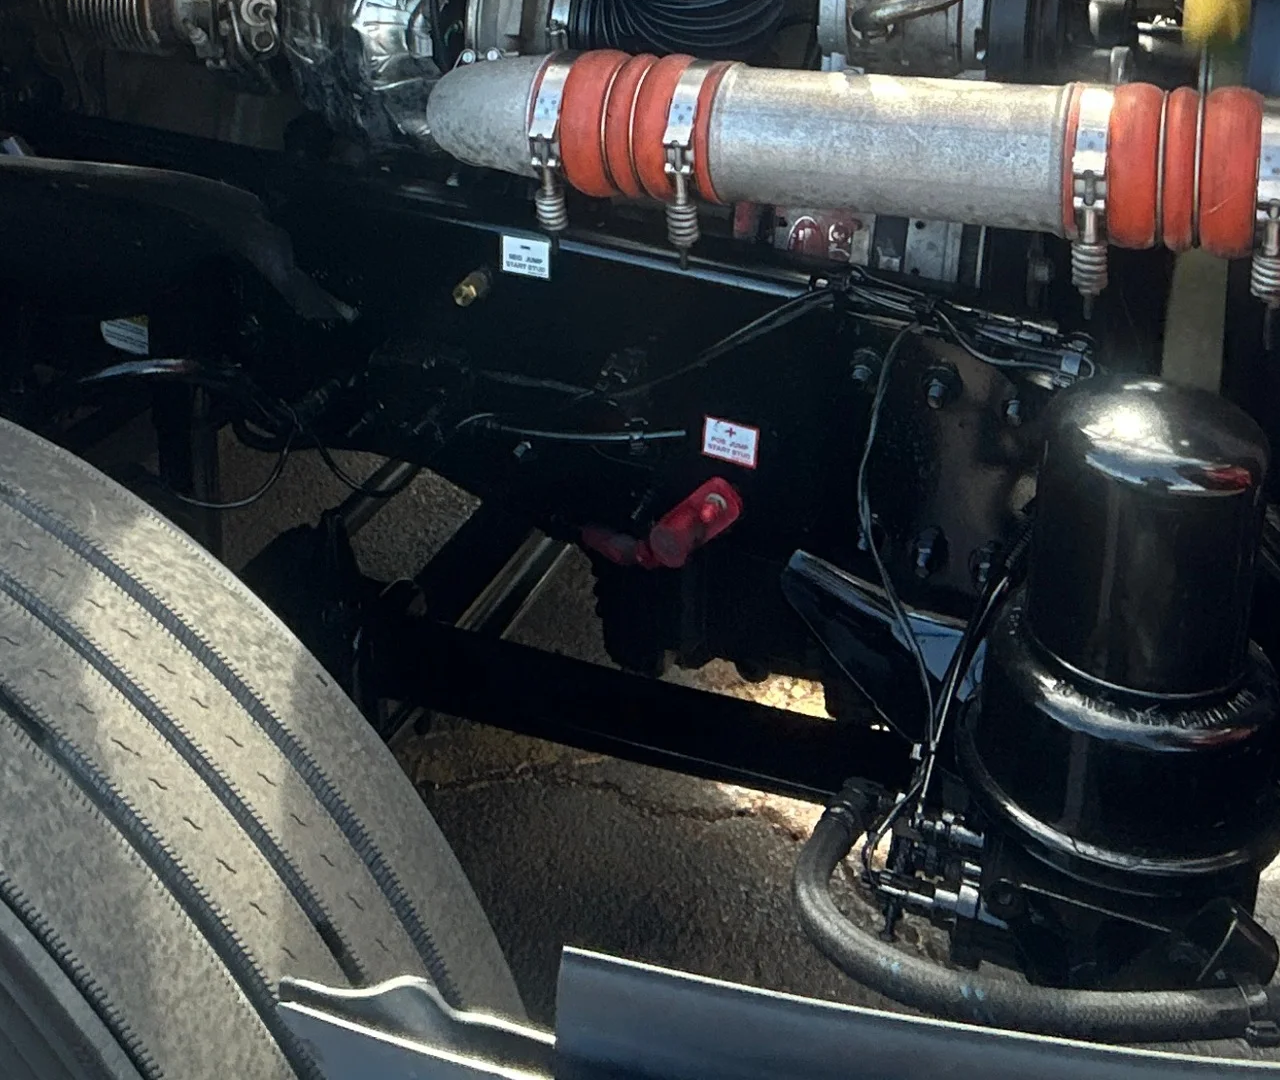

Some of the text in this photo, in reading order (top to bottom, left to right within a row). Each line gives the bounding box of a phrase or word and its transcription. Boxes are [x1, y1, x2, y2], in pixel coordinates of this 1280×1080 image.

[525, 255, 543, 264] JUMP
[506, 261, 546, 273] START STUD
[711, 436, 749, 450] POS JUMP
[708, 443, 751, 460] START STUD
